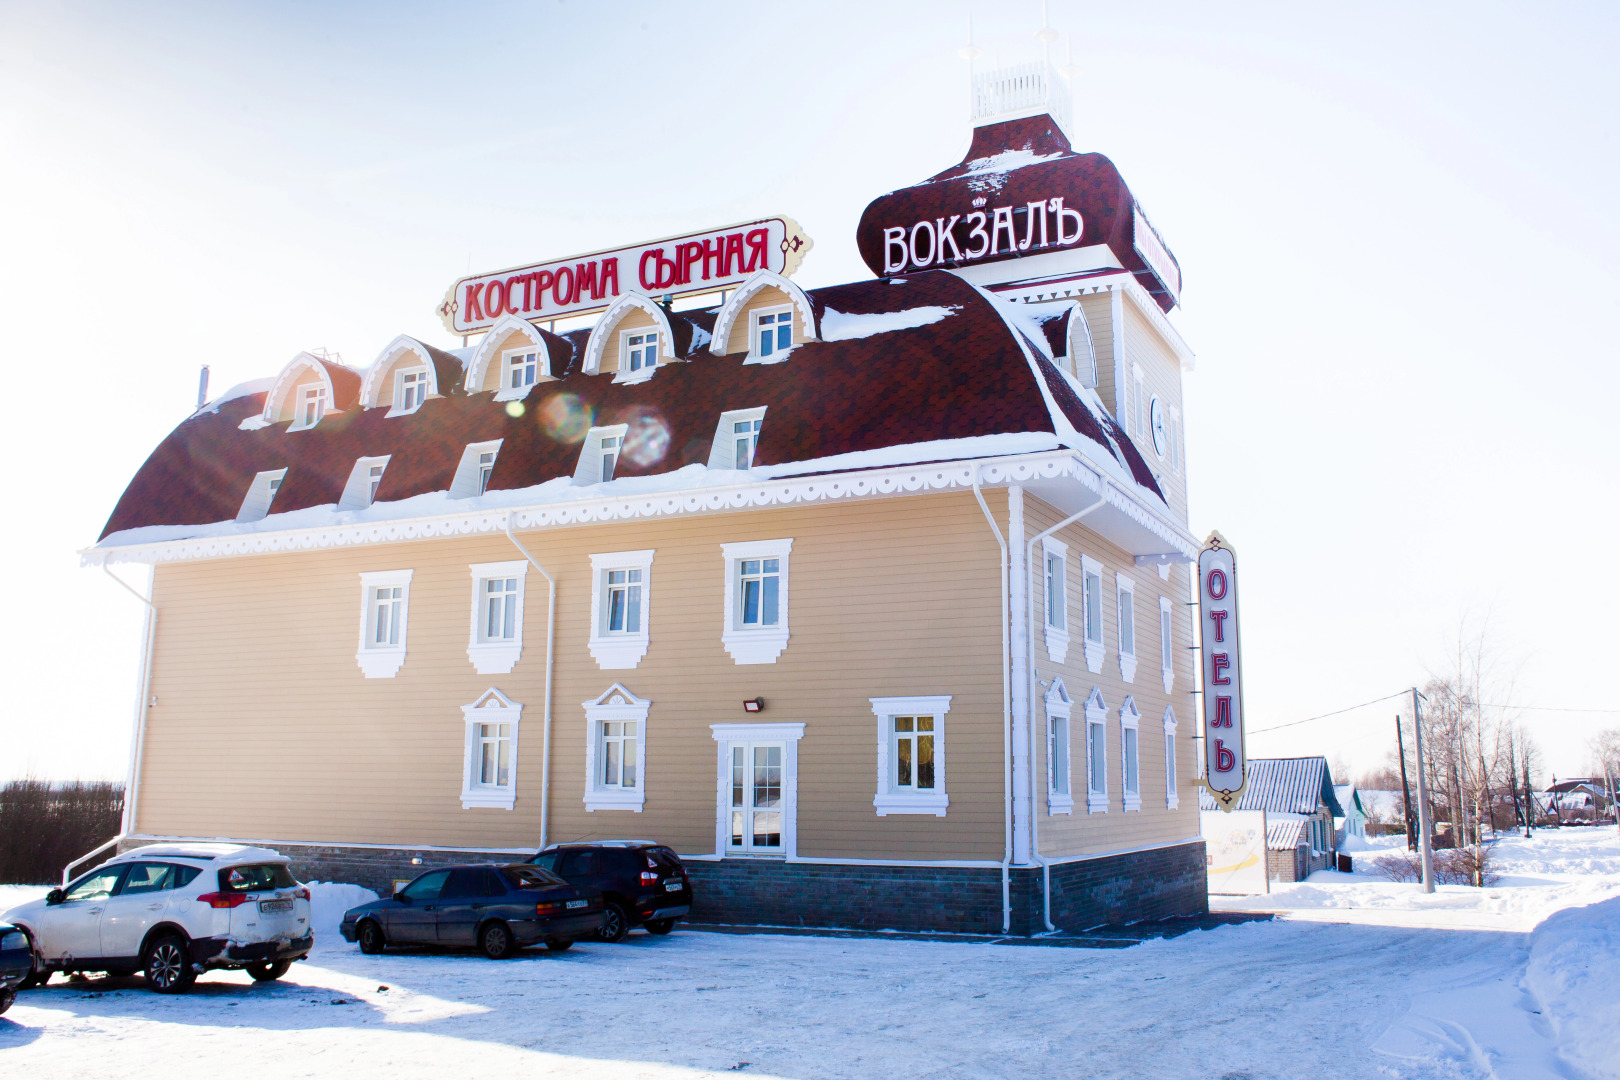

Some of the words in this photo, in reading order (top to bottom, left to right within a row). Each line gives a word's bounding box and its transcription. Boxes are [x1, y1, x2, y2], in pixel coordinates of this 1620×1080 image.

[463, 256, 620, 323] КОСТРОМА
[638, 228, 769, 291] СЫРНАЯ
[883, 197, 1084, 274] ВОКЗАЛЪ
[1206, 568, 1236, 774] ОТЕЛЬ
